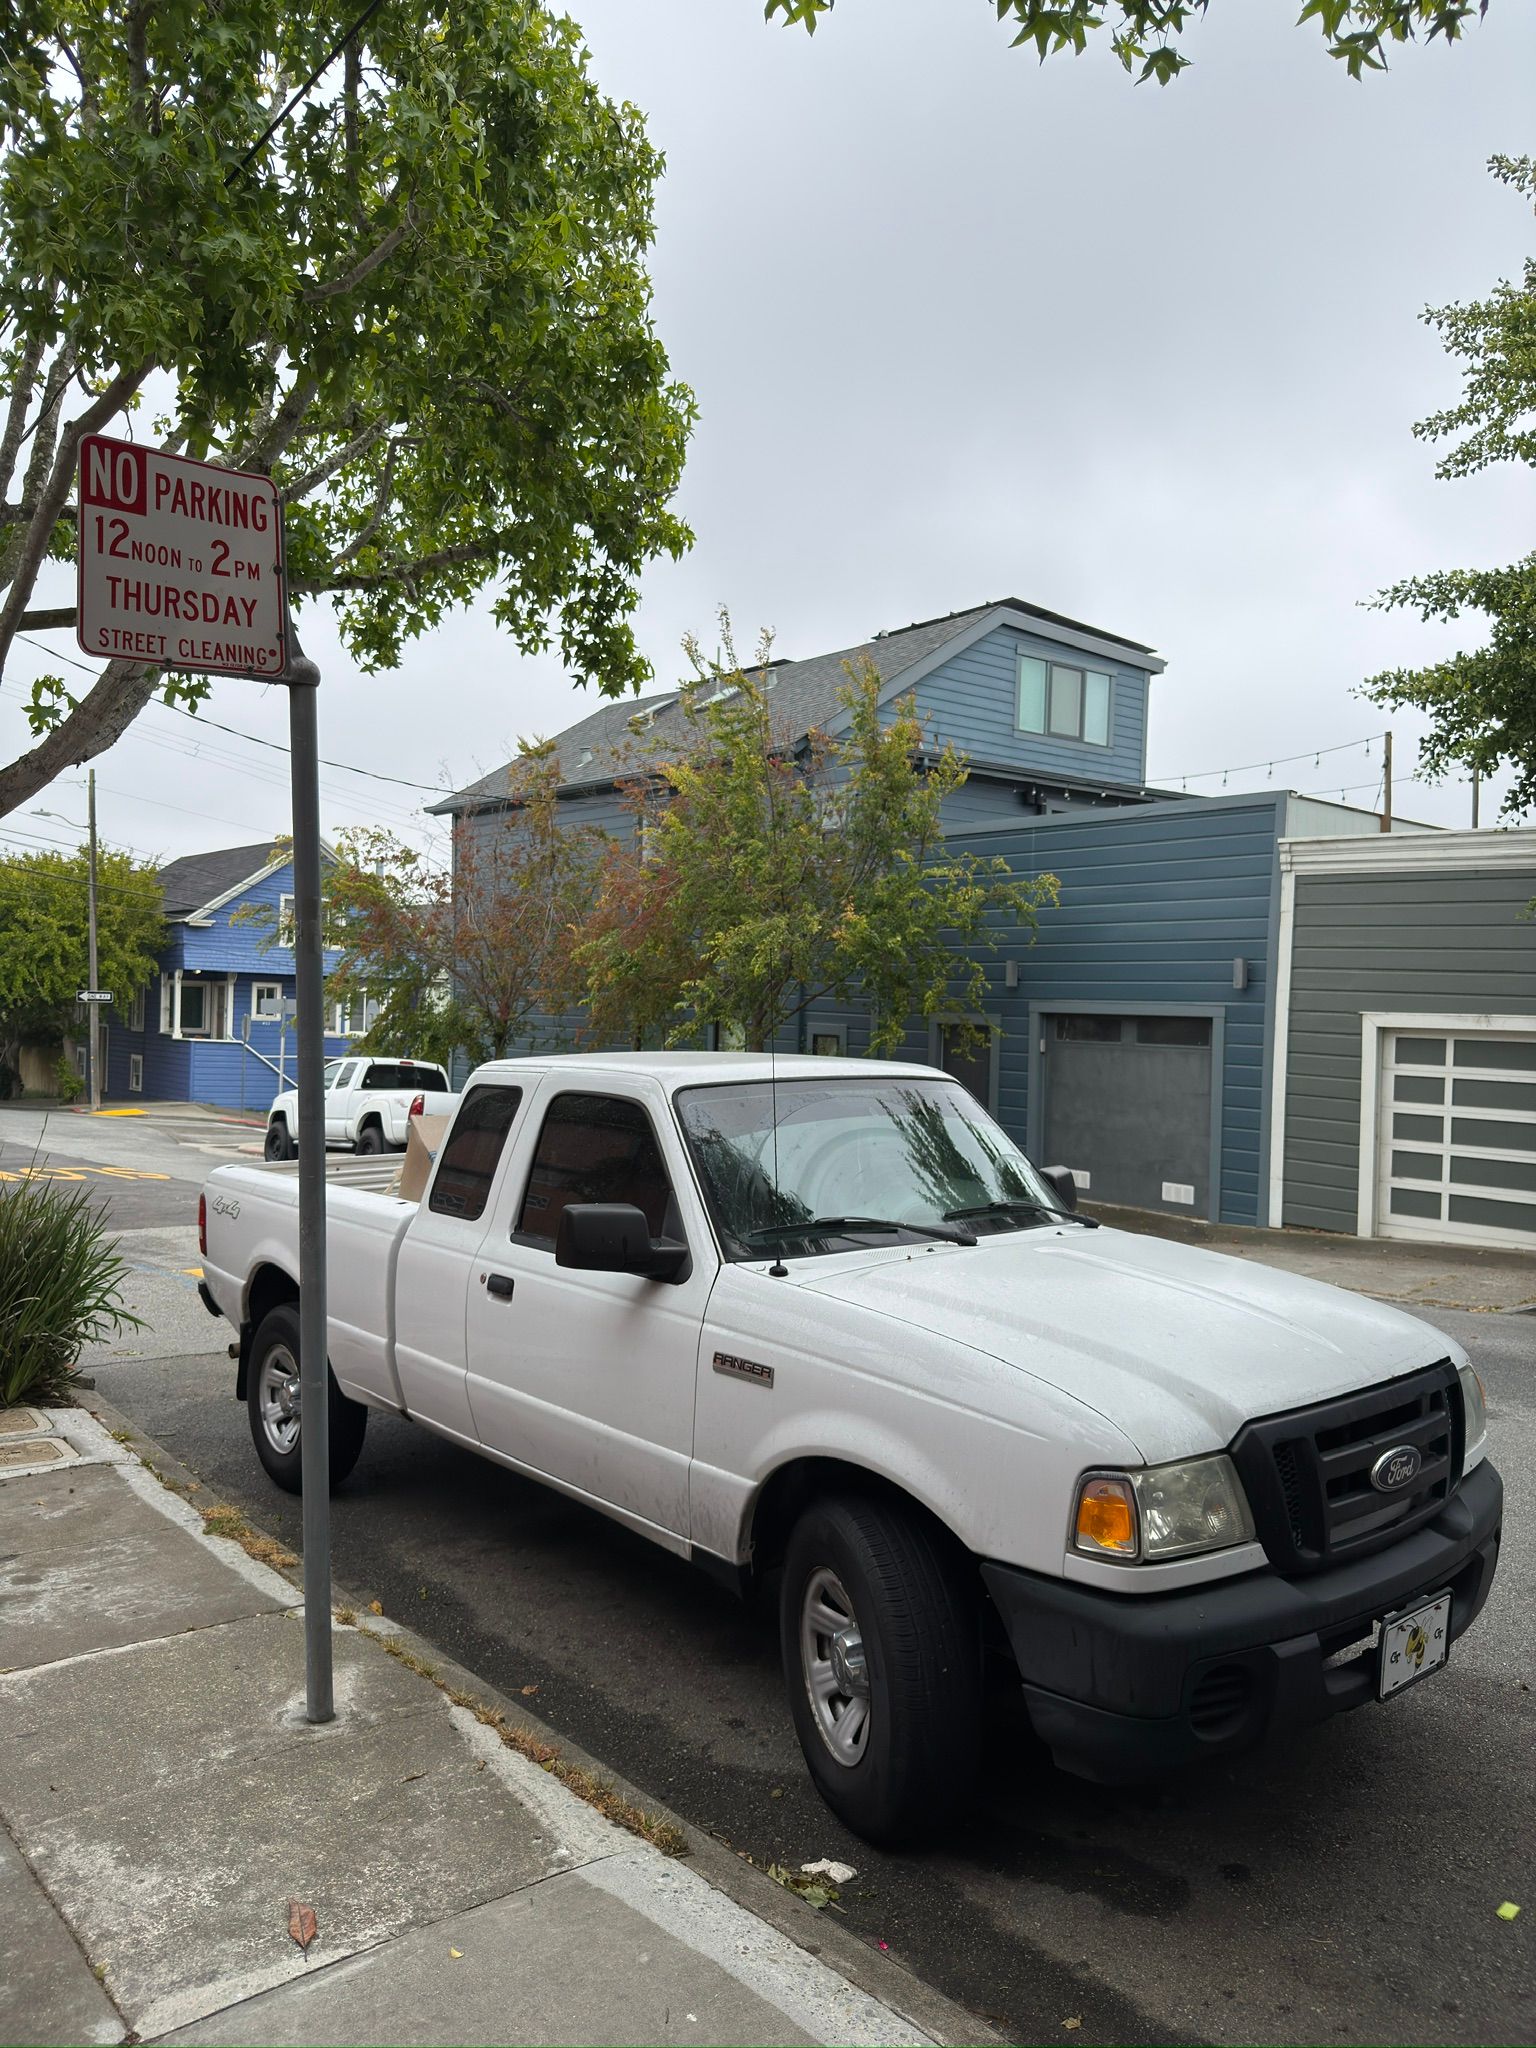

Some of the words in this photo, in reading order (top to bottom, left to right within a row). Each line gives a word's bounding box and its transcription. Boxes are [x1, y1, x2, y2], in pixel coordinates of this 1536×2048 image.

[89, 444, 139, 505] NO
[155, 473, 267, 532] PARKING
[188, 558, 203, 573] TO
[106, 576, 258, 628] THURSDAY
[99, 627, 168, 655] STREET
[178, 638, 267, 666] CLEANING
[713, 1352, 772, 1379] RANGER
[1387, 1455, 1415, 1485] Ford
